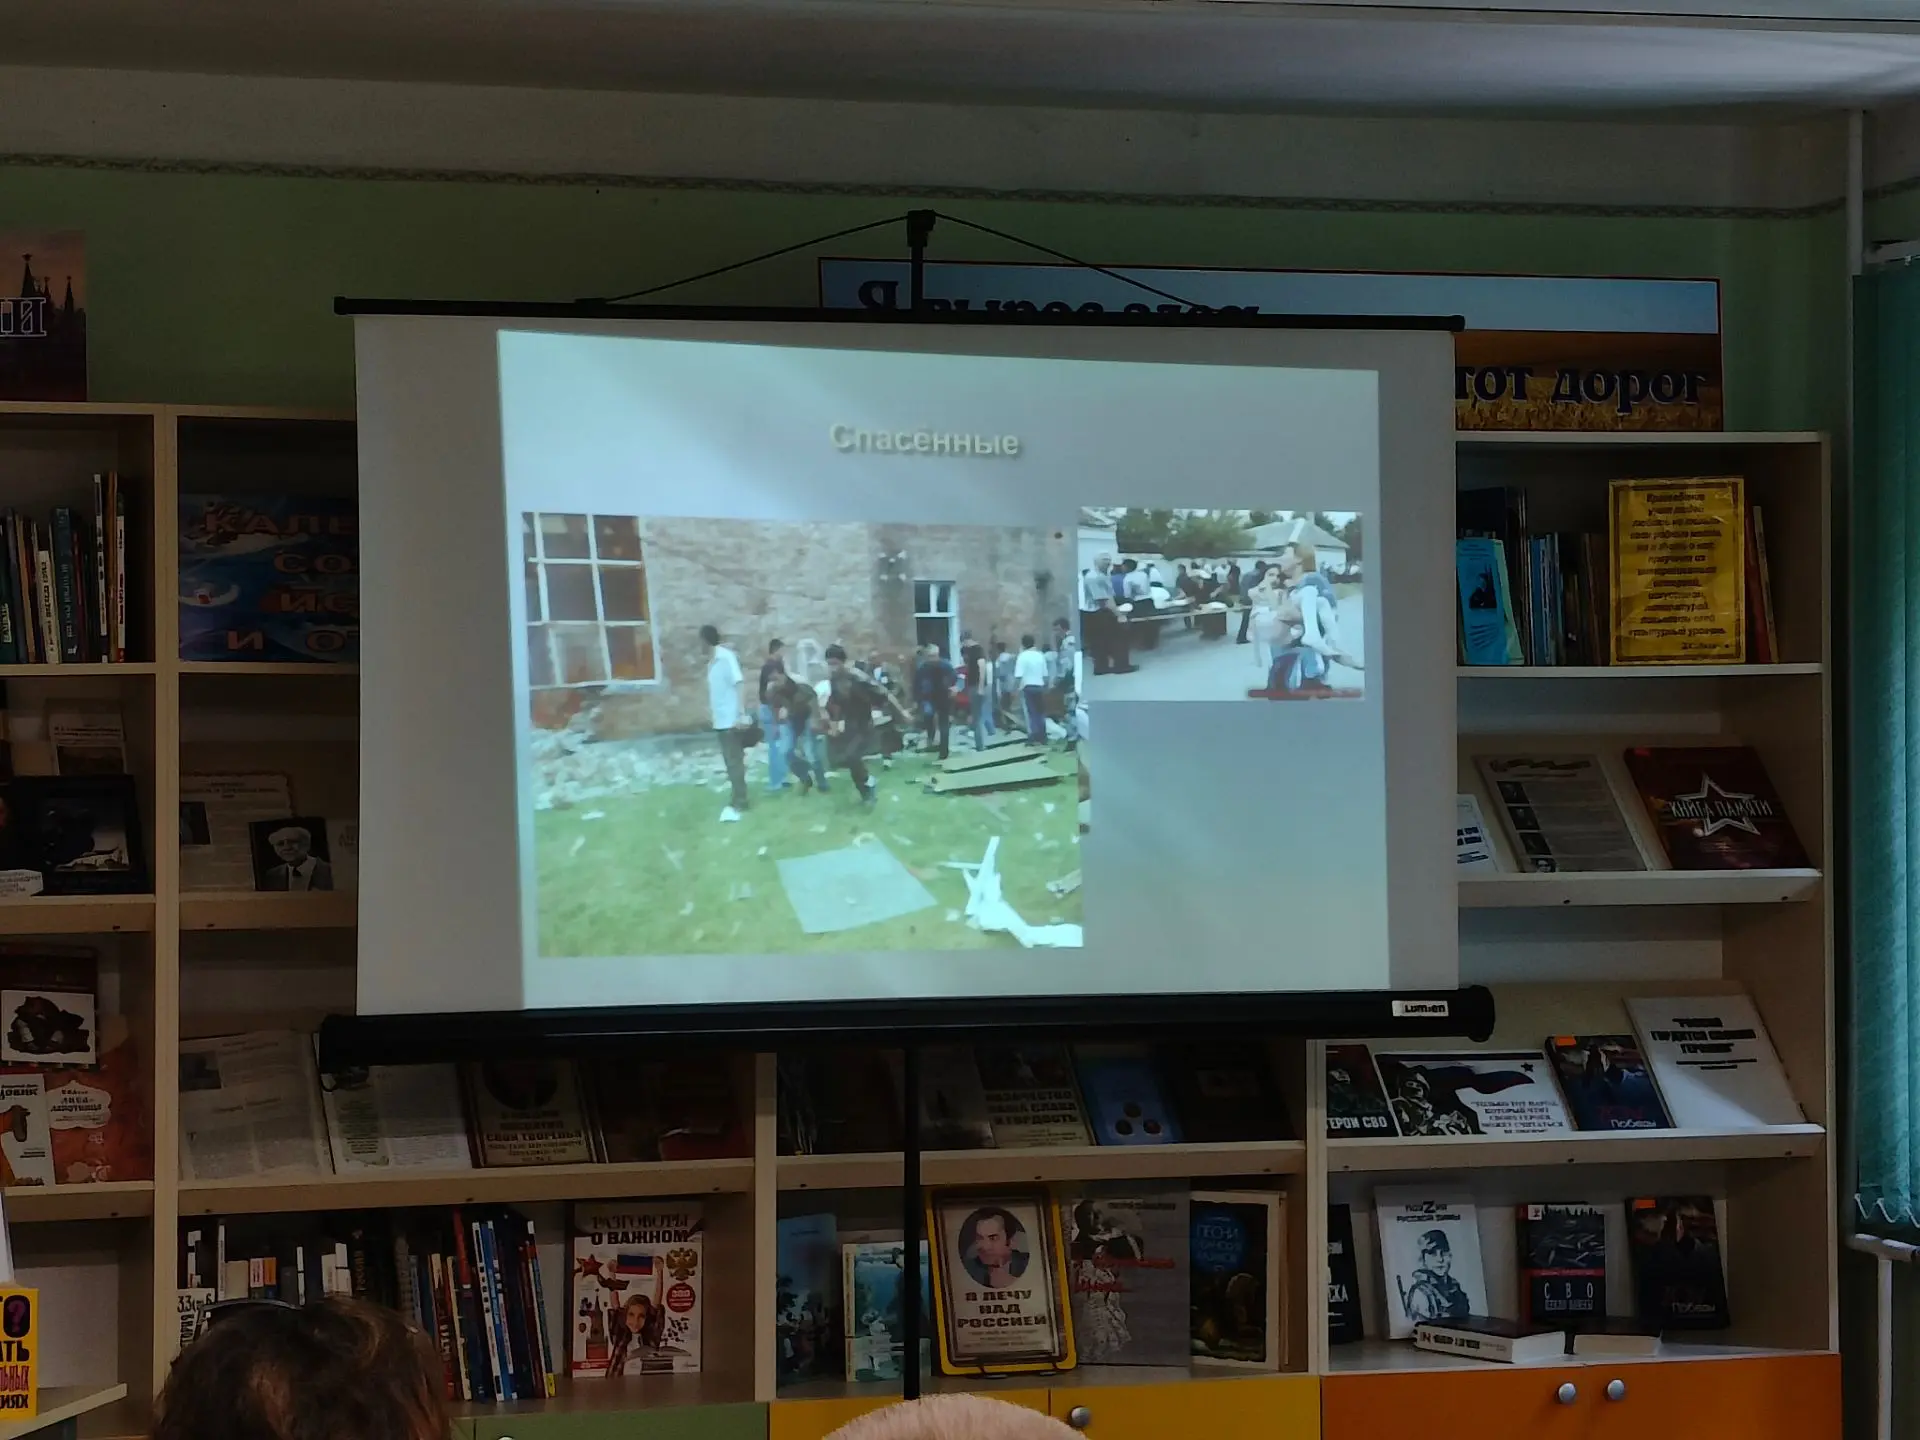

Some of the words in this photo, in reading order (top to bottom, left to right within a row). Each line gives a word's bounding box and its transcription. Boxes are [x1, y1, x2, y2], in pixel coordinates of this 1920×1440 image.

[1550, 367, 1709, 417] дорог
[1669, 801, 1714, 818] КНИГА
[1715, 799, 1773, 817] ПАМЯТИ
[591, 1212, 690, 1230] РАЗГОВОРЫ
[591, 1231, 603, 1246] О
[607, 1229, 690, 1245] ВАЖНОМ
[978, 1303, 1021, 1315] НАД
